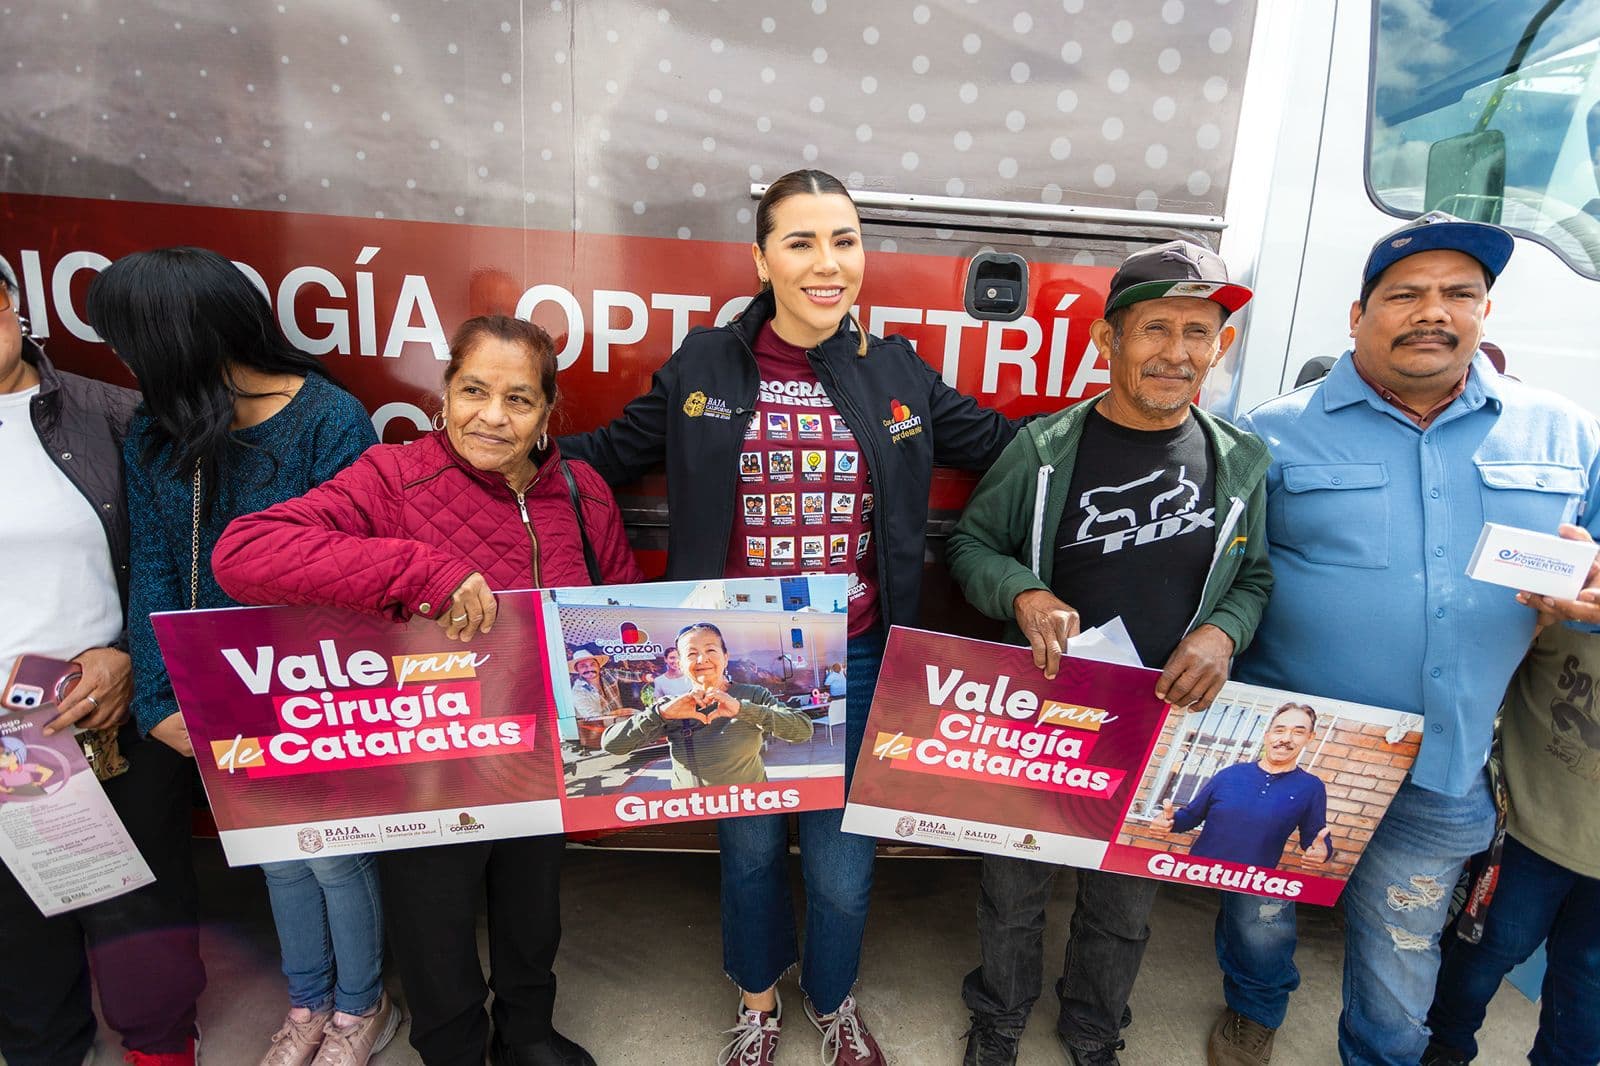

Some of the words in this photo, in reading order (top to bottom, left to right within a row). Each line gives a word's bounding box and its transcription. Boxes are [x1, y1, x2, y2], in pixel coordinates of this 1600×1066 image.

[707, 397, 726, 408] BAJA
[890, 414, 922, 434] corazón
[1060, 507, 1216, 554] FOX
[604, 641, 662, 654] corazón
[221, 640, 388, 695] Vale
[398, 650, 491, 690] para
[925, 664, 1039, 719] Vale
[1035, 702, 1119, 727] para
[281, 685, 470, 729] Cirugía
[940, 713, 1083, 759] Cirugía
[218, 734, 265, 774] de
[269, 719, 522, 764] Cataratas
[874, 732, 913, 760] de
[915, 739, 1111, 791] Cataratas
[615, 785, 800, 822] Gratuitas
[324, 826, 361, 837] BAJA
[385, 822, 427, 833] SALUD
[450, 822, 485, 833] corazón
[917, 827, 956, 836] CALIFORNIA
[919, 820, 947, 830] BAJA
[325, 832, 376, 842] CALIFORNIA
[964, 829, 997, 840] SALUD
[1013, 842, 1041, 851] corazón
[1147, 853, 1304, 899] Gratuitas
